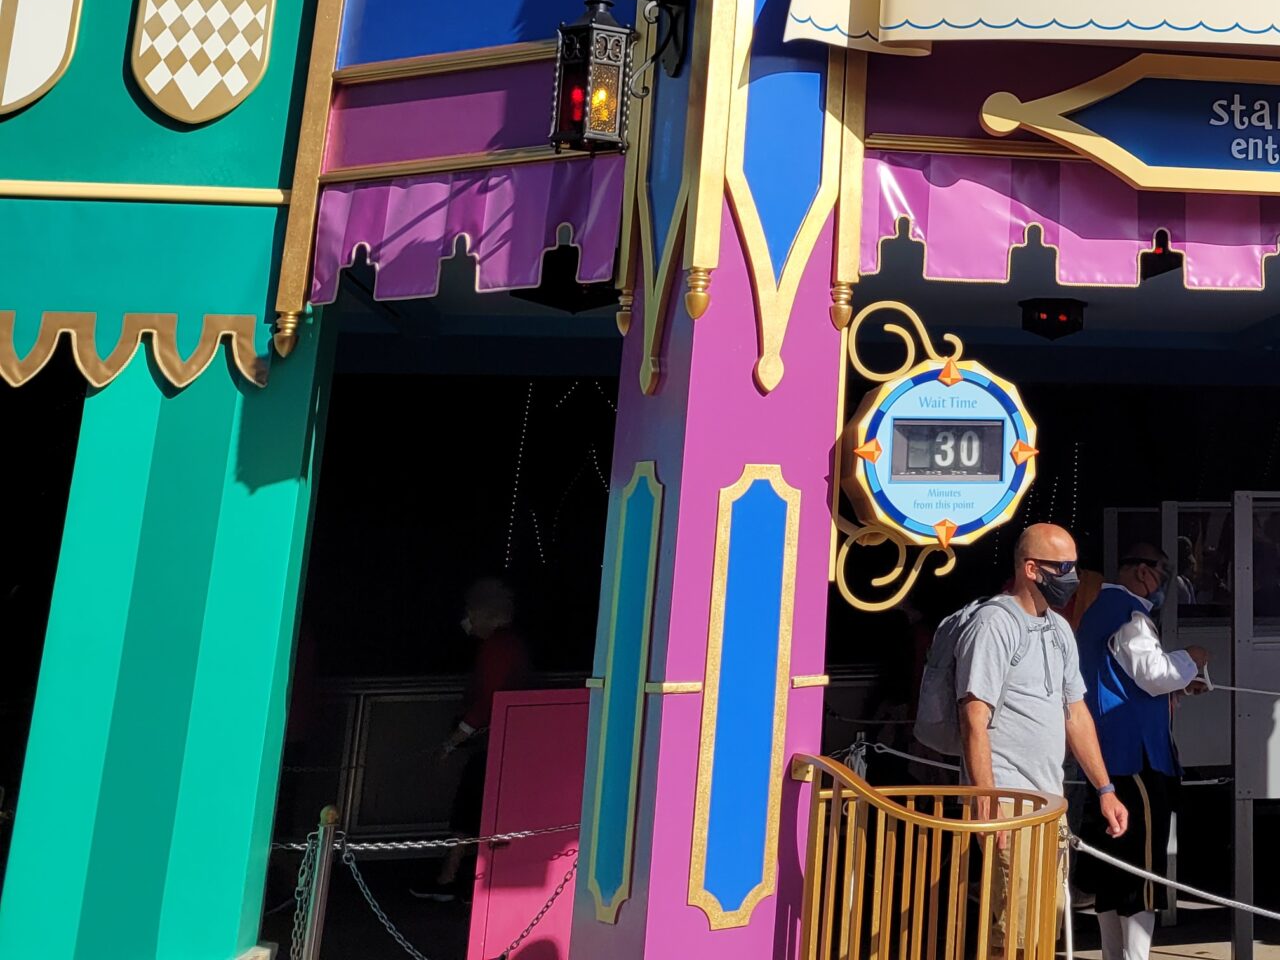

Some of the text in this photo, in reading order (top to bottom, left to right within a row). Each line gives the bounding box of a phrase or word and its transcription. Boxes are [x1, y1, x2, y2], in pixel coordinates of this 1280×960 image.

[919, 396, 978, 409] Wait Time
[934, 431, 980, 467] 30
[927, 488, 961, 497] Minutes
[913, 500, 975, 511] from this point
